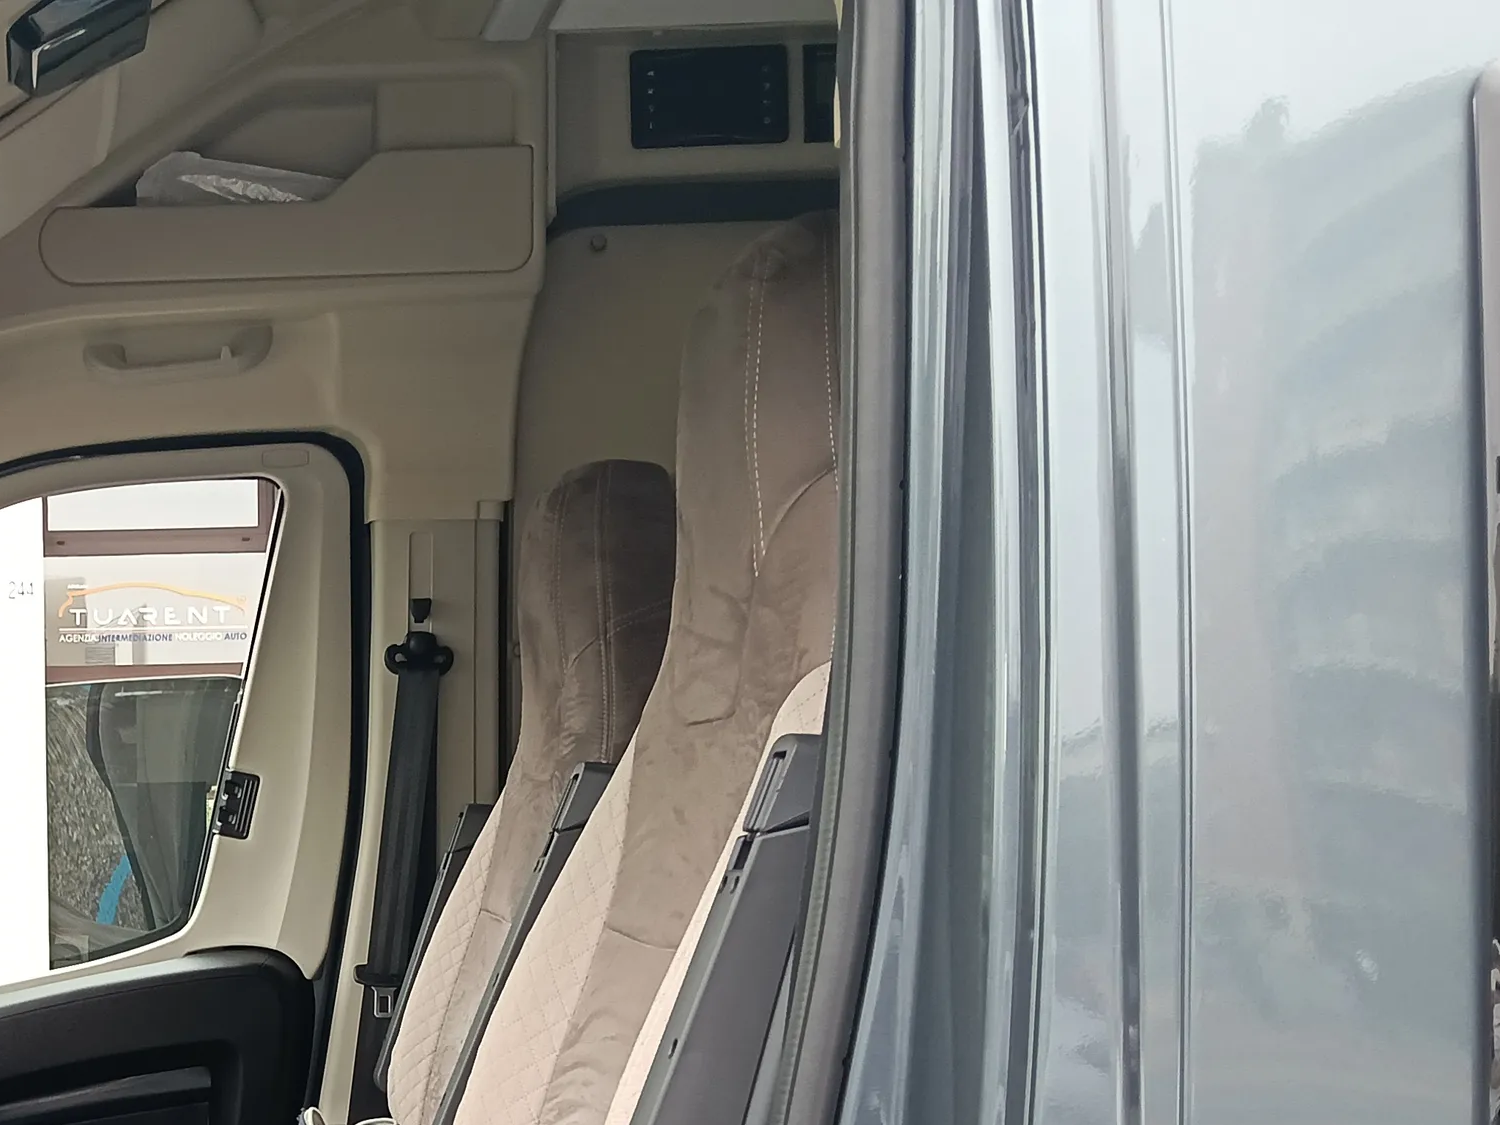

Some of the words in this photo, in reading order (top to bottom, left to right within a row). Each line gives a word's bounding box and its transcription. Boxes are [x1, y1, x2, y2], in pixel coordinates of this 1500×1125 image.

[69, 605, 231, 626] TUARENT
[98, 632, 173, 643] INTERMEDIAZIONE
[174, 631, 223, 642] NOLEGGIO
[224, 631, 248, 641] AUTO
